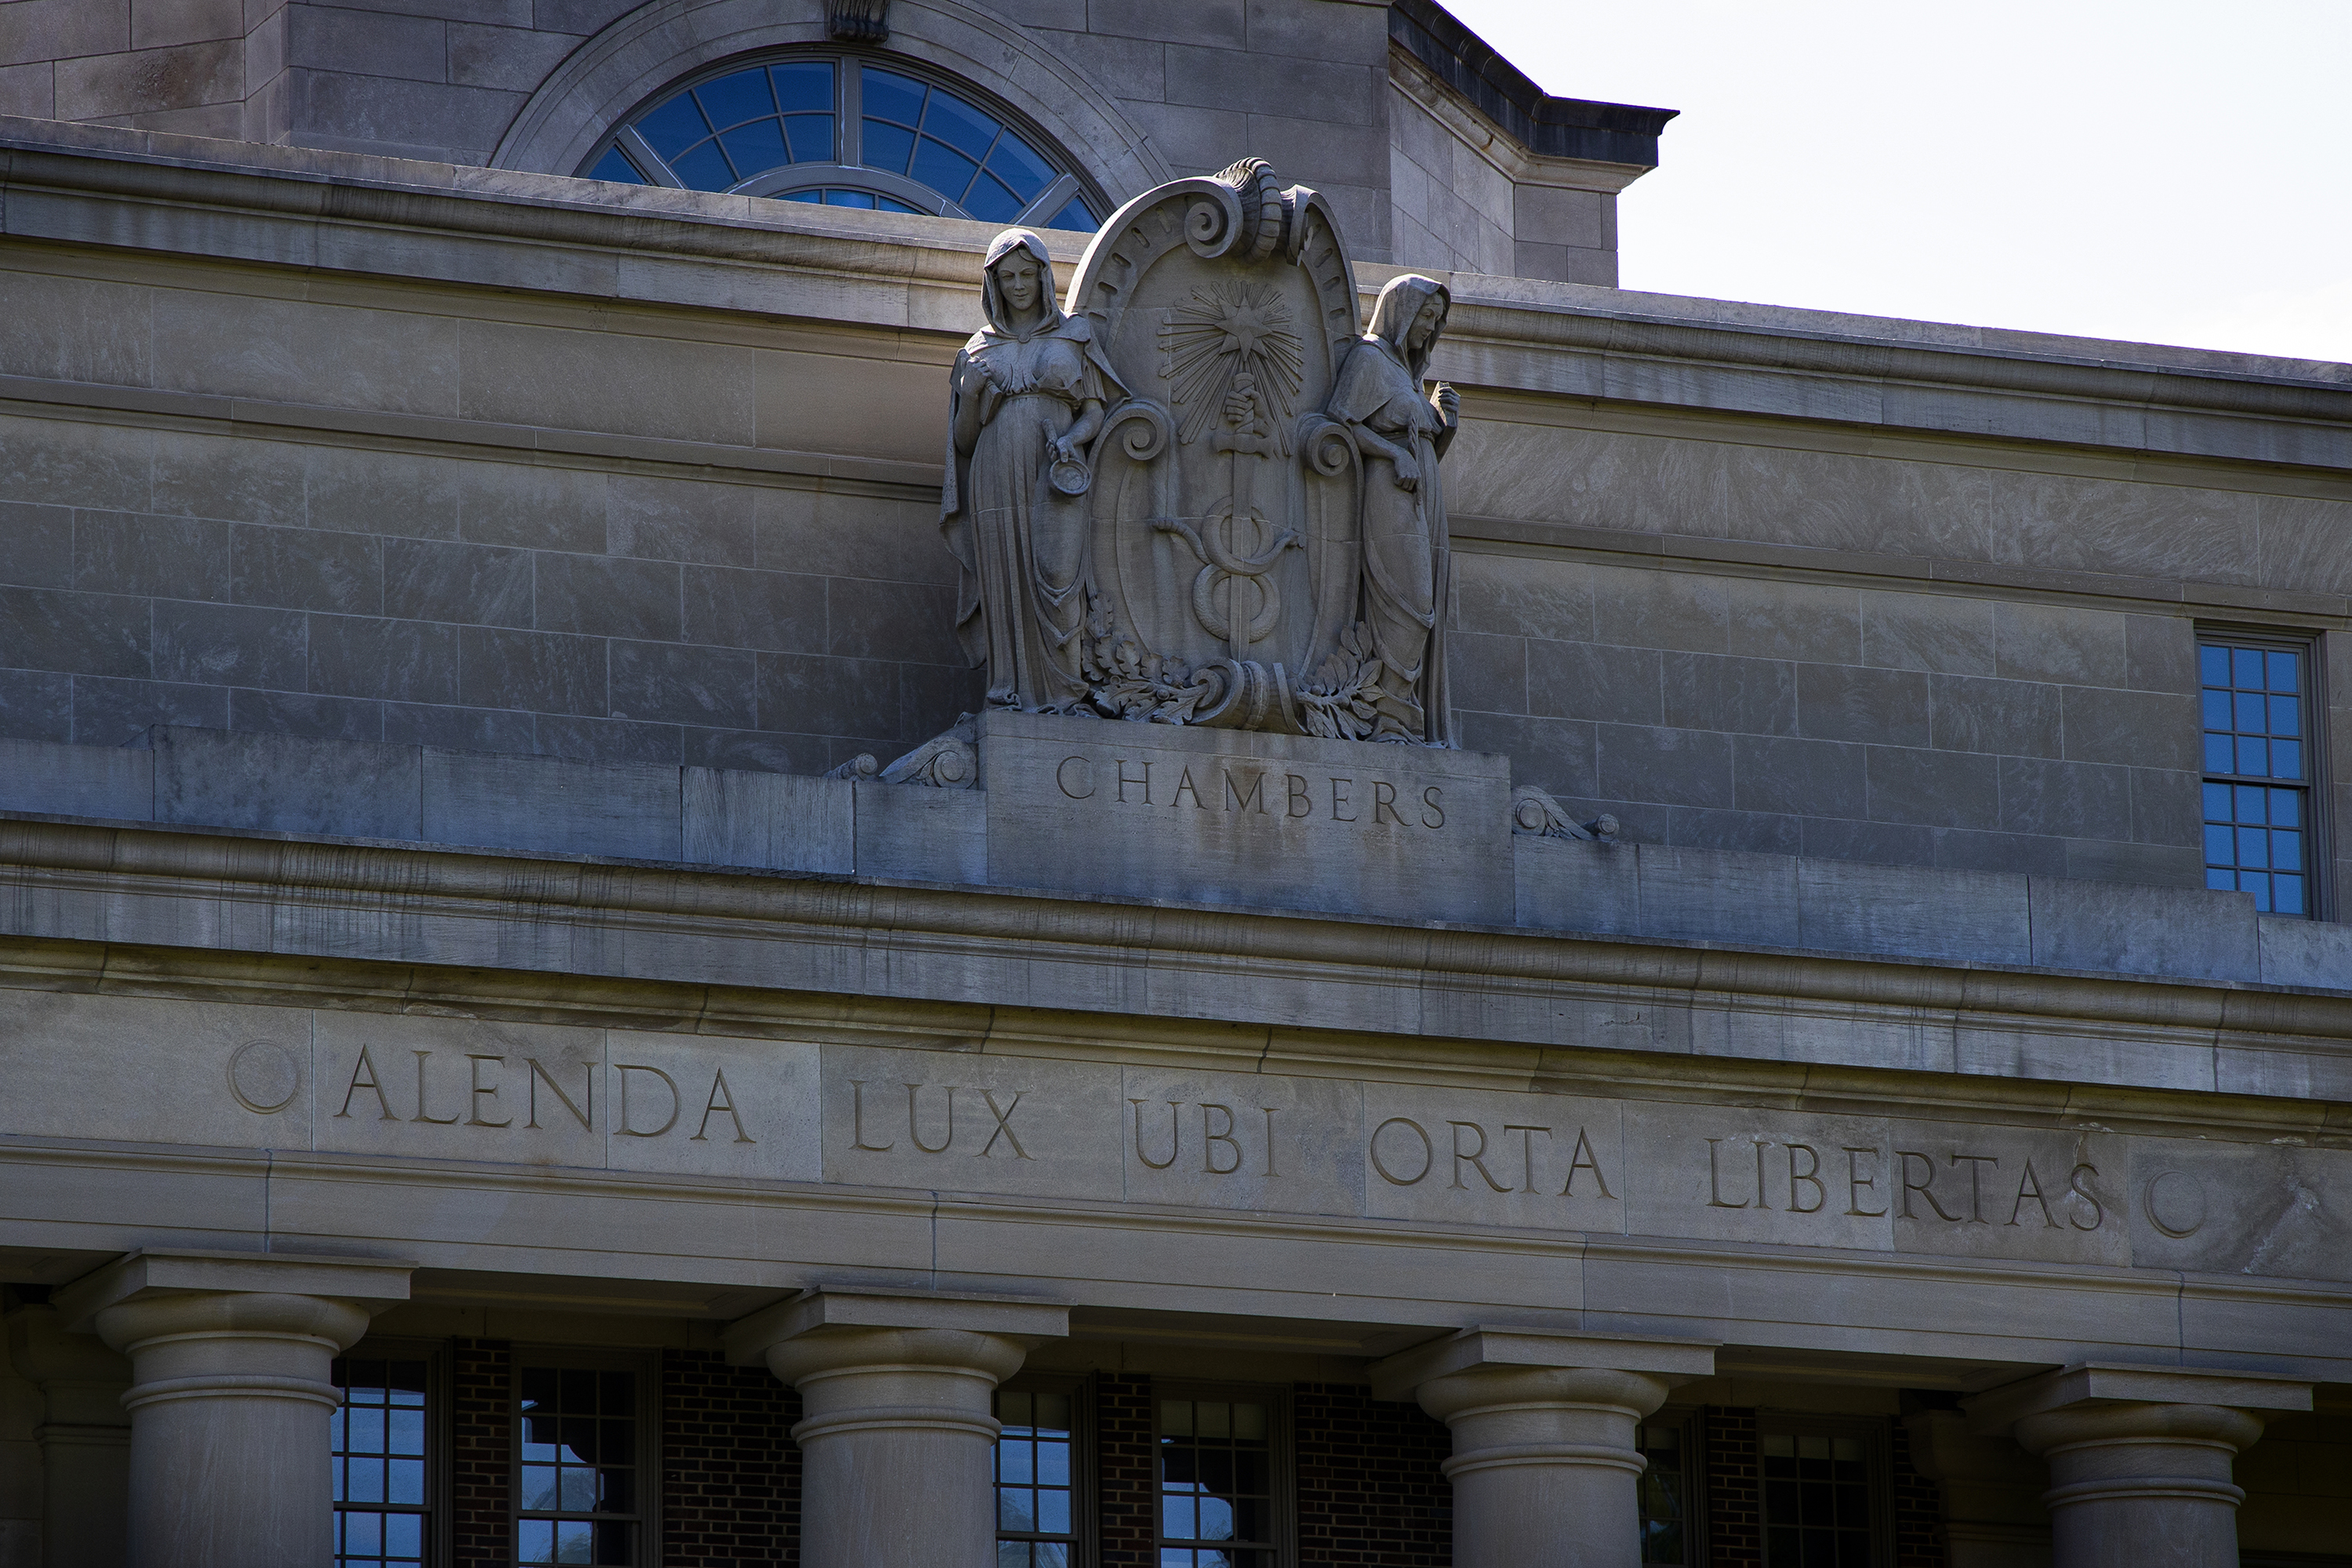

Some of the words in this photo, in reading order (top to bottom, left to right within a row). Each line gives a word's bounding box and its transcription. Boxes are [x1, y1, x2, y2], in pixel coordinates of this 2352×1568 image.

[1056, 755, 1446, 830] CHAMBERS
[332, 1044, 757, 1144] ALENDA
[848, 1080, 1037, 1161] LUX
[1127, 1098, 1282, 1177] UBI
[1370, 1116, 1619, 1200] ORTA
[1703, 1138, 2104, 1232] LIBERTAS
